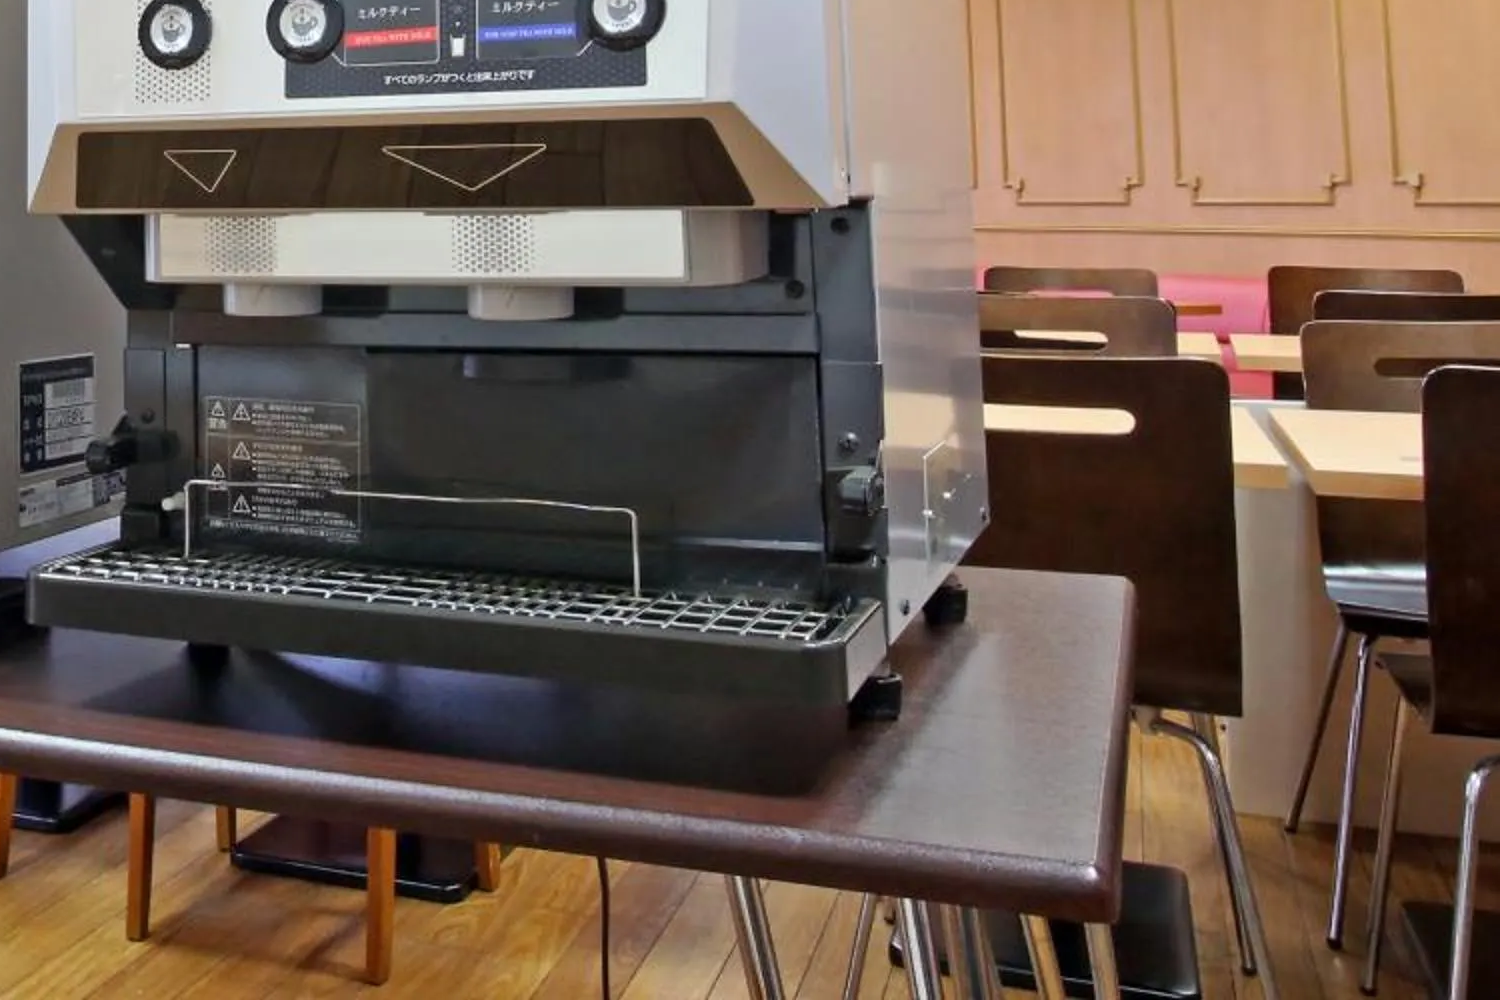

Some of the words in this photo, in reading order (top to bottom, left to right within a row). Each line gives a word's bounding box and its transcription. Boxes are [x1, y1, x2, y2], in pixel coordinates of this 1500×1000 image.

[357, 3, 422, 20] ミルクティー
[491, 0, 562, 14] ミルクティー
